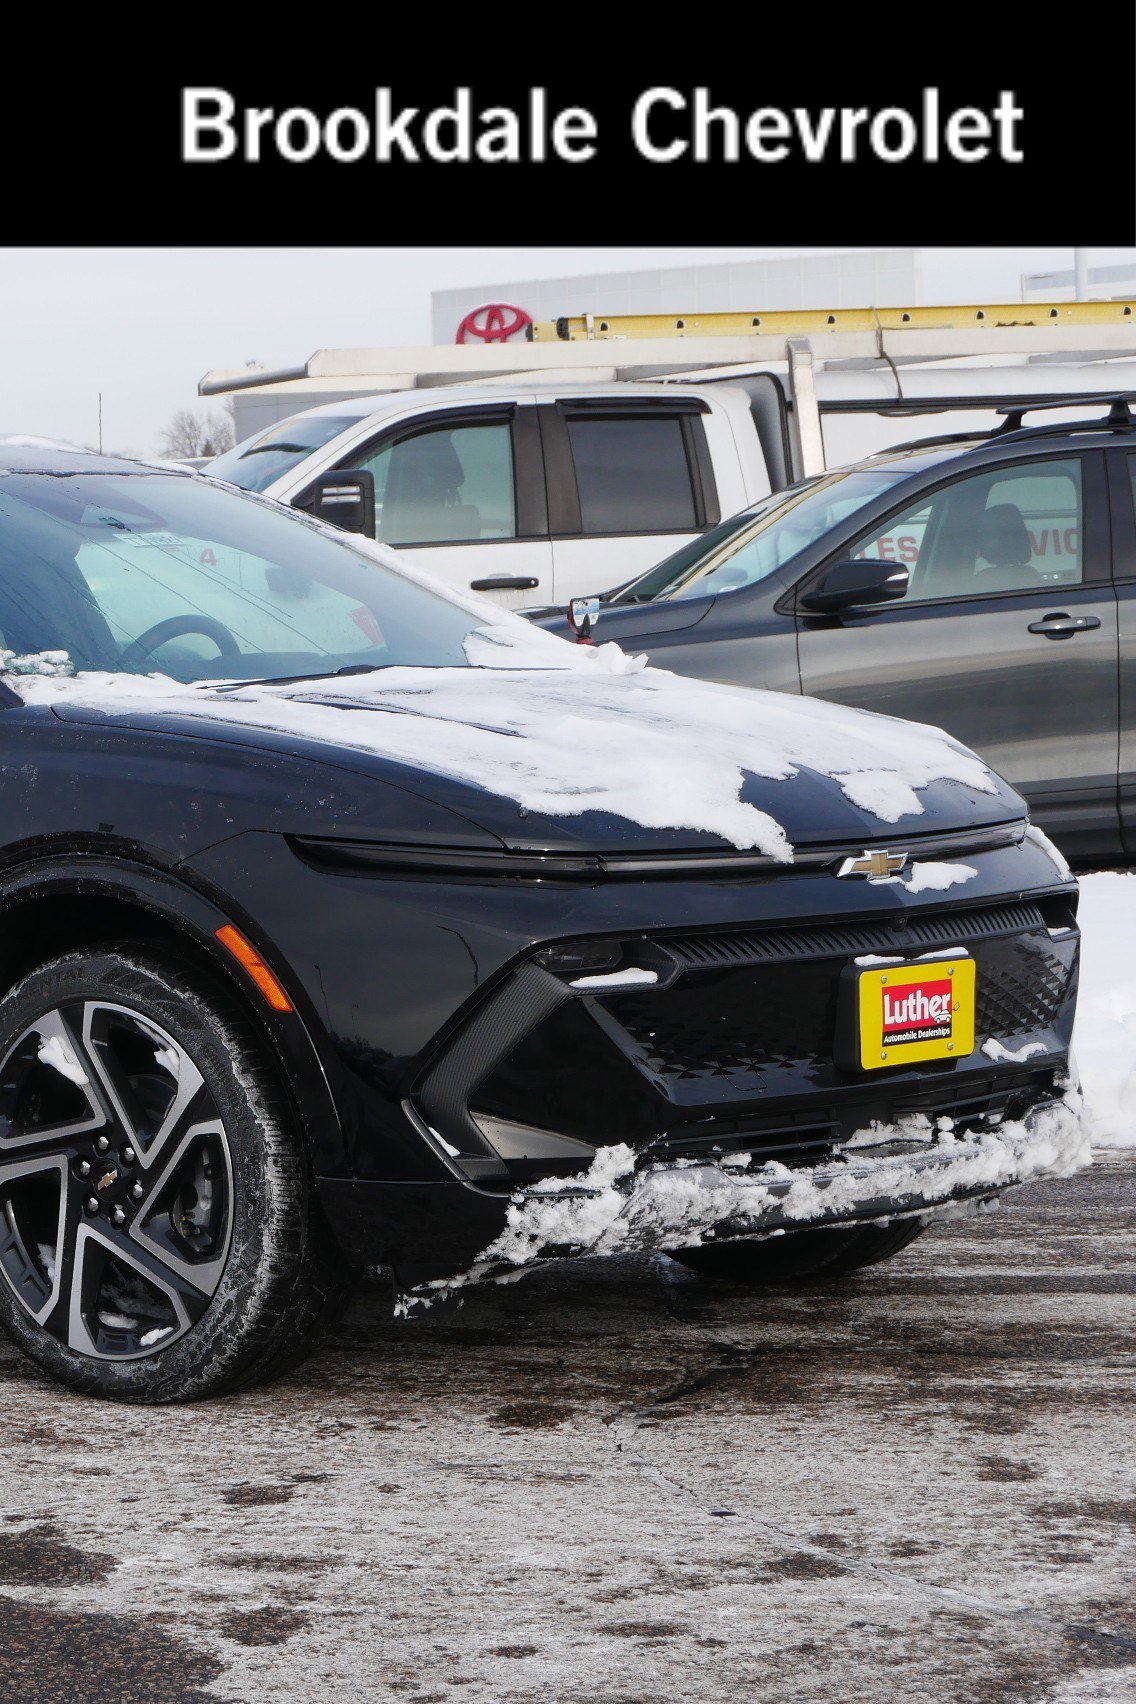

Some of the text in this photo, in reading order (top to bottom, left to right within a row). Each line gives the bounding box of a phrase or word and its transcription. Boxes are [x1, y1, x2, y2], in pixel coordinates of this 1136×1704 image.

[883, 989, 951, 1025] Luther
[883, 1026, 950, 1044] Automobile Dealerships
